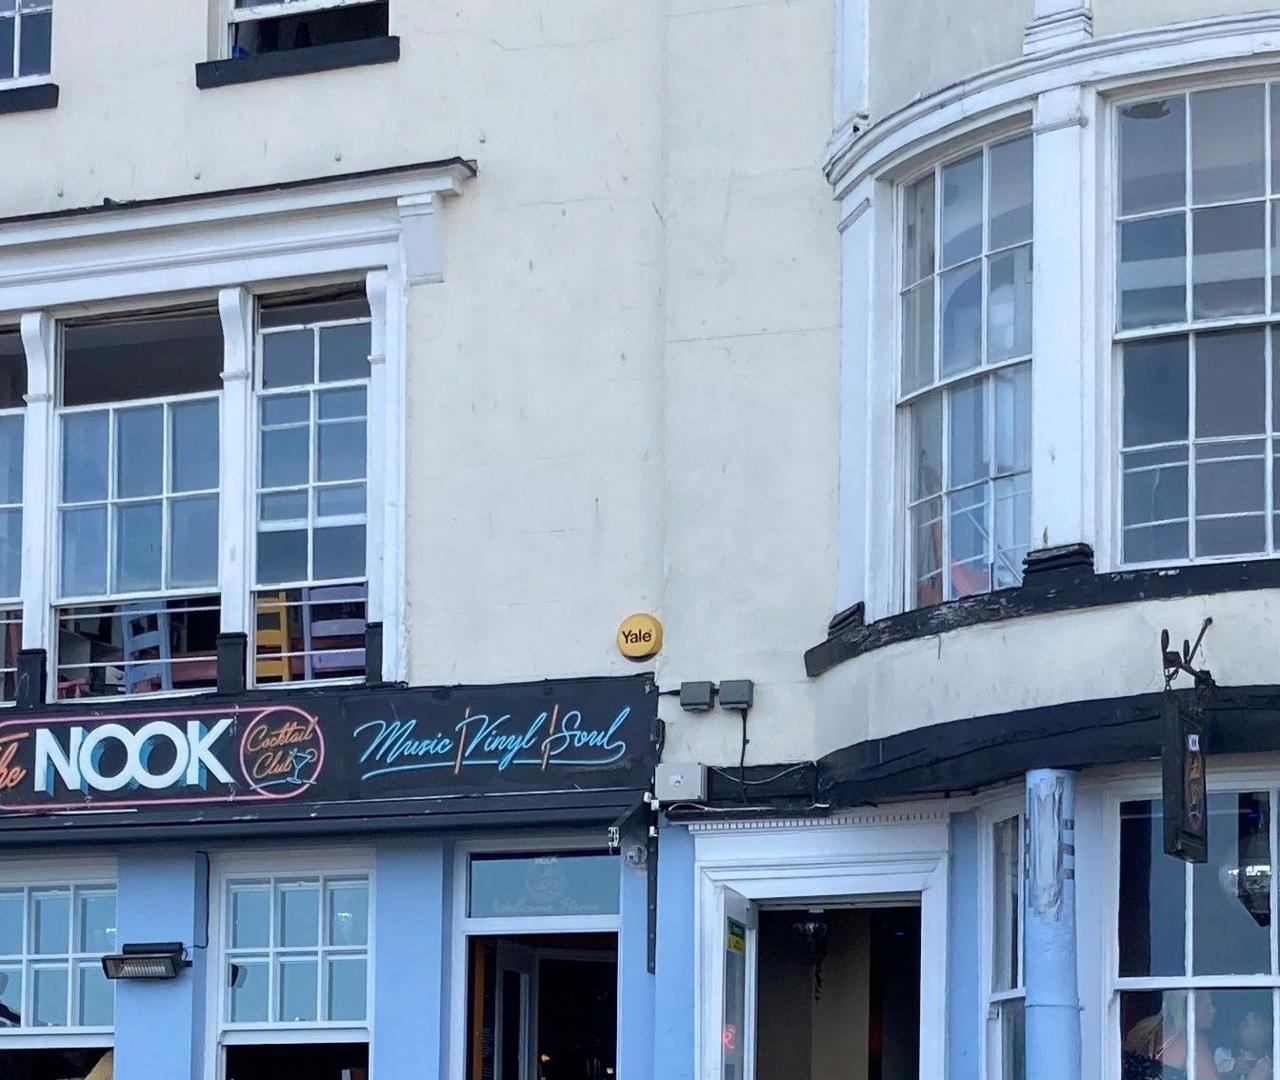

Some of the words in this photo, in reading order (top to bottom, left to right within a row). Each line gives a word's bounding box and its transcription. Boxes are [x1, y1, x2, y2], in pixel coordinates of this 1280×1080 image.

[622, 629, 652, 644] Yale
[247, 716, 318, 752] Cocktail
[354, 719, 453, 763] Music
[455, 712, 547, 772] Vinyl
[542, 706, 630, 756] Soul
[34, 719, 237, 796] NOOK
[253, 747, 303, 779] Club
